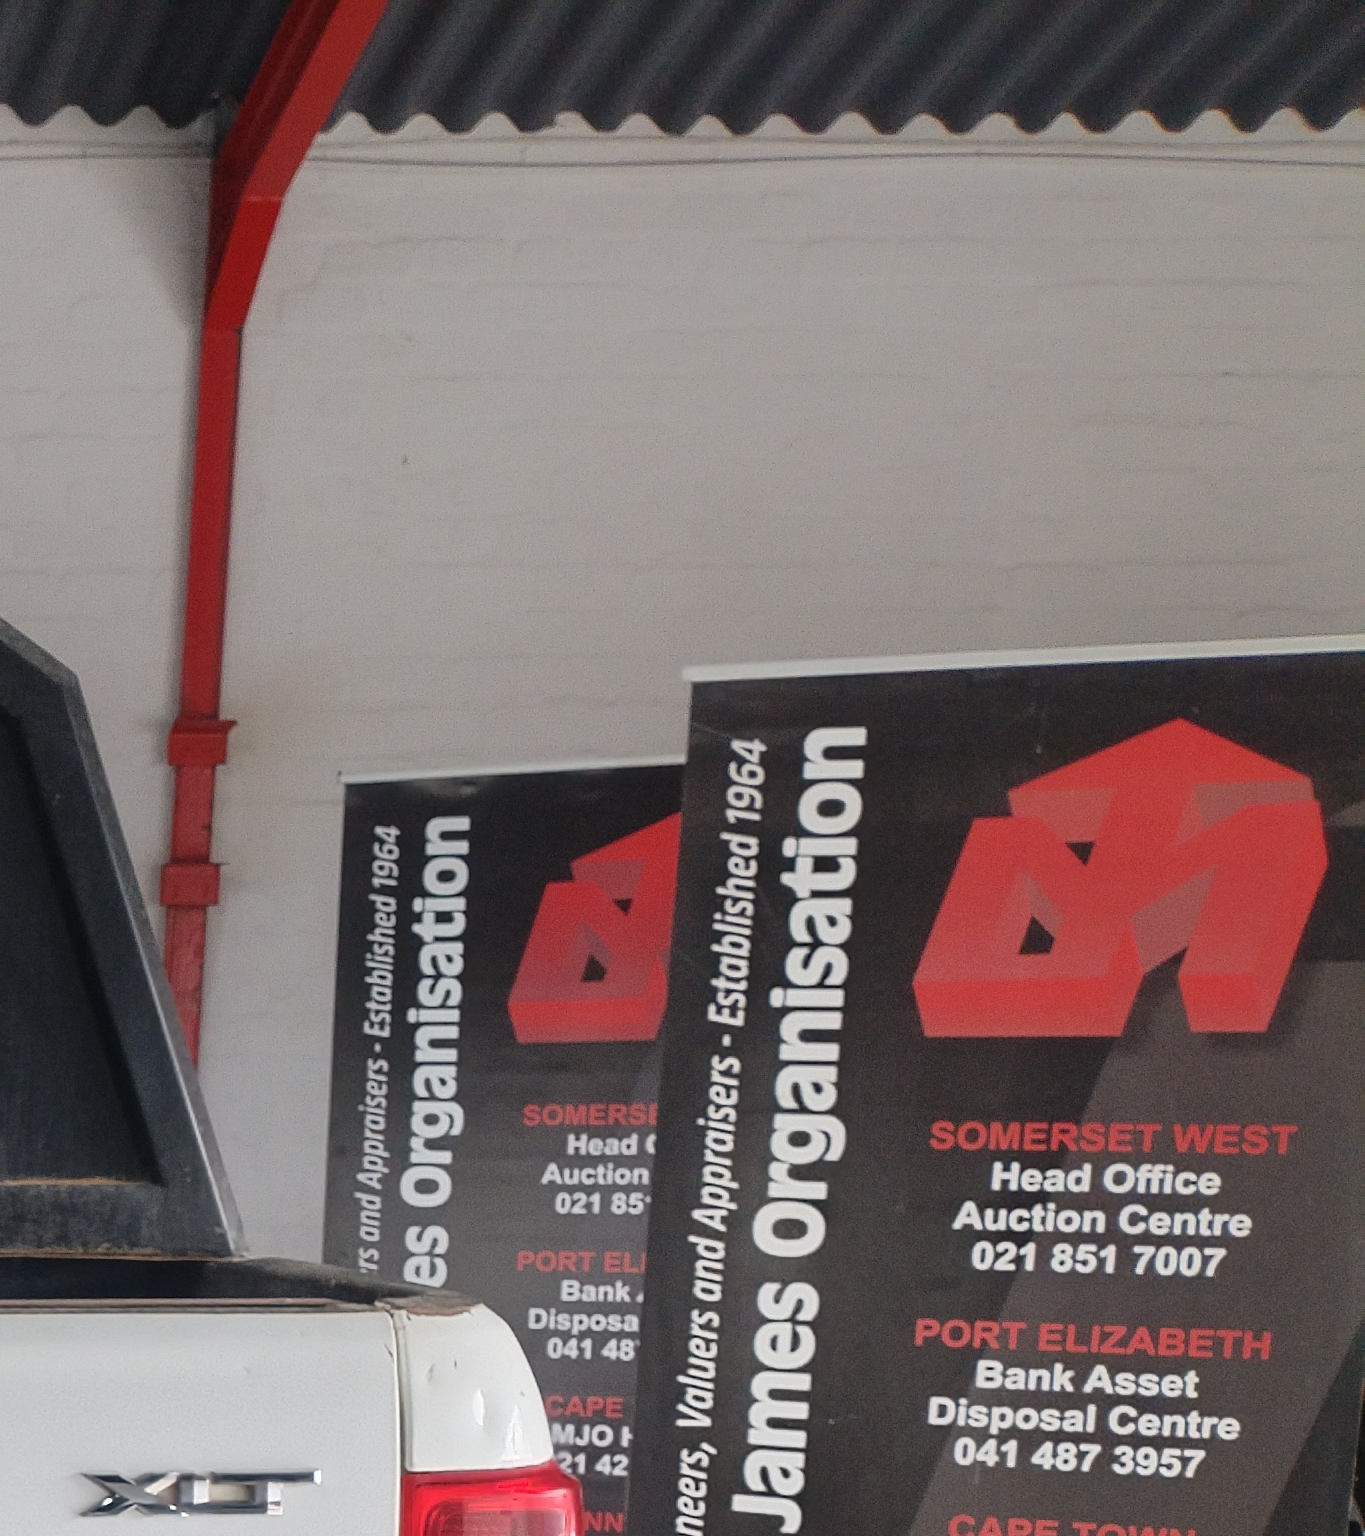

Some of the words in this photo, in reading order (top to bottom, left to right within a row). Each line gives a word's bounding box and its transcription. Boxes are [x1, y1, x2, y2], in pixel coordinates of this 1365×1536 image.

[726, 739, 767, 823] 1964
[372, 826, 400, 887] 1964
[708, 832, 759, 1026] Established
[363, 894, 396, 1037] Established
[399, 816, 470, 1208] Organisation
[751, 726, 868, 1258] Organisation
[356, 1059, 390, 1190] Appraisers
[567, 1133, 638, 1155] Head
[692, 1055, 740, 1232] Appraisers
[931, 1121, 1161, 1151] SOMERSET
[1174, 1124, 1297, 1154] WEST
[541, 1163, 649, 1185] Auction
[991, 1162, 1092, 1193] Head
[1103, 1163, 1221, 1195] Office
[354, 1192, 382, 1242] and
[555, 1192, 600, 1214] 021
[952, 1201, 1106, 1233] Auction
[1119, 1204, 1252, 1237] Centre
[358, 1247, 380, 1274] rs
[517, 1251, 595, 1272] PORT
[682, 1236, 727, 1301] and
[972, 1241, 1036, 1271] 021
[1051, 1243, 1116, 1273] 851
[1133, 1246, 1227, 1277] 7007
[561, 1280, 630, 1302] Bank
[547, 1337, 592, 1359] 041
[600, 1338, 641, 1361] 48
[915, 1319, 1026, 1349] PORT
[1038, 1323, 1271, 1360] ELIZABETH
[676, 1309, 719, 1427] Valuers
[975, 1360, 1074, 1392] Bank
[1083, 1365, 1199, 1398] Asset
[545, 1396, 624, 1418] CAPE
[731, 1282, 819, 1533] James
[928, 1397, 1096, 1435] Disposal
[1109, 1405, 1240, 1440] Centre
[552, 1423, 614, 1447] MJO
[954, 1437, 1017, 1468] 041
[1031, 1441, 1101, 1472] 487
[1112, 1446, 1206, 1478] 3957
